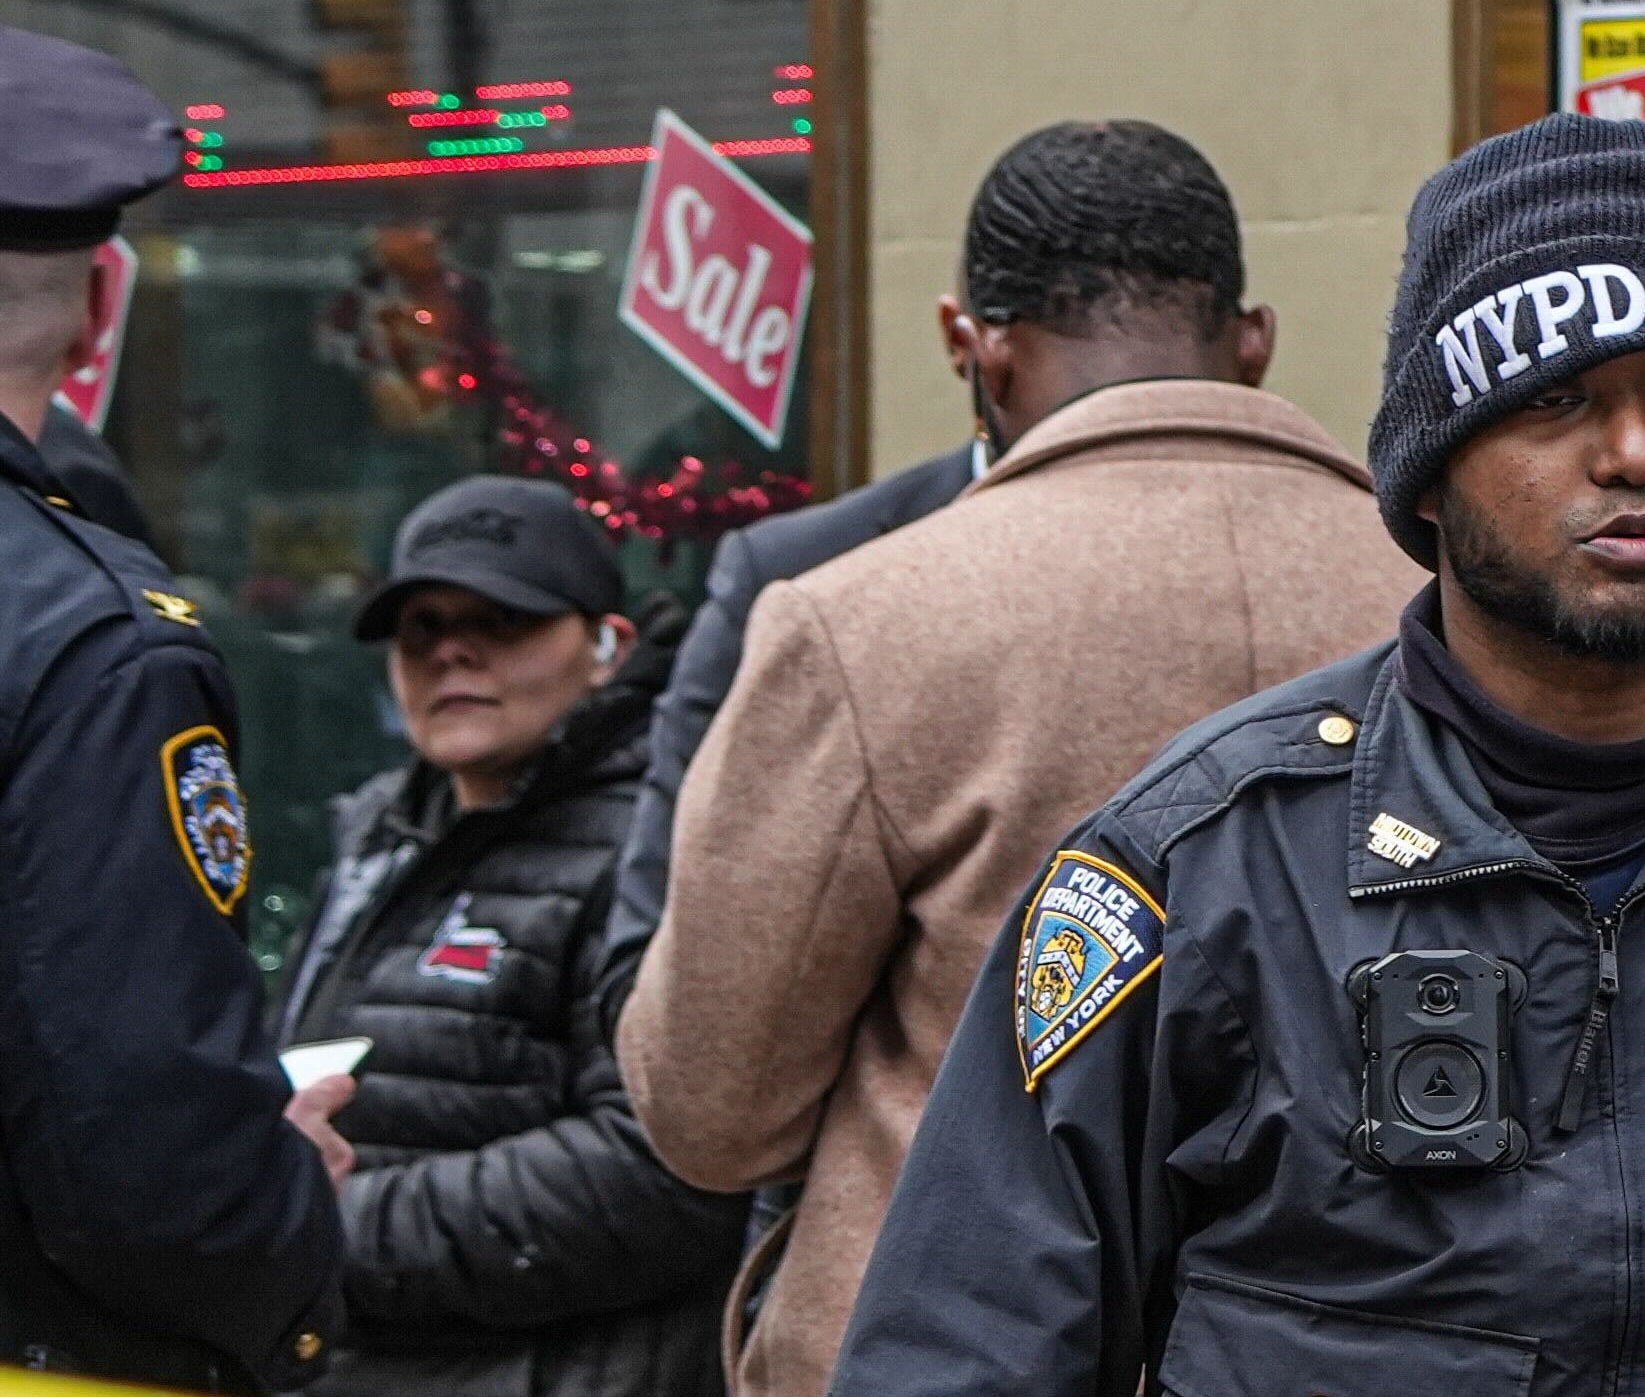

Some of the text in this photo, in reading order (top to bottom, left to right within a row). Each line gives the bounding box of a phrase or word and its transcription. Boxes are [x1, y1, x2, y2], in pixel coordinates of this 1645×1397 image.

[640, 183, 791, 390] Sale
[1367, 835, 1418, 869] SOUTH
[1369, 812, 1441, 860] MIDTOWN
[1067, 866, 1141, 922] POLICE
[1040, 886, 1145, 964] DEPARTMENT
[1031, 973, 1125, 1066] NEW YORK
[1425, 1150, 1457, 1161] AXON
